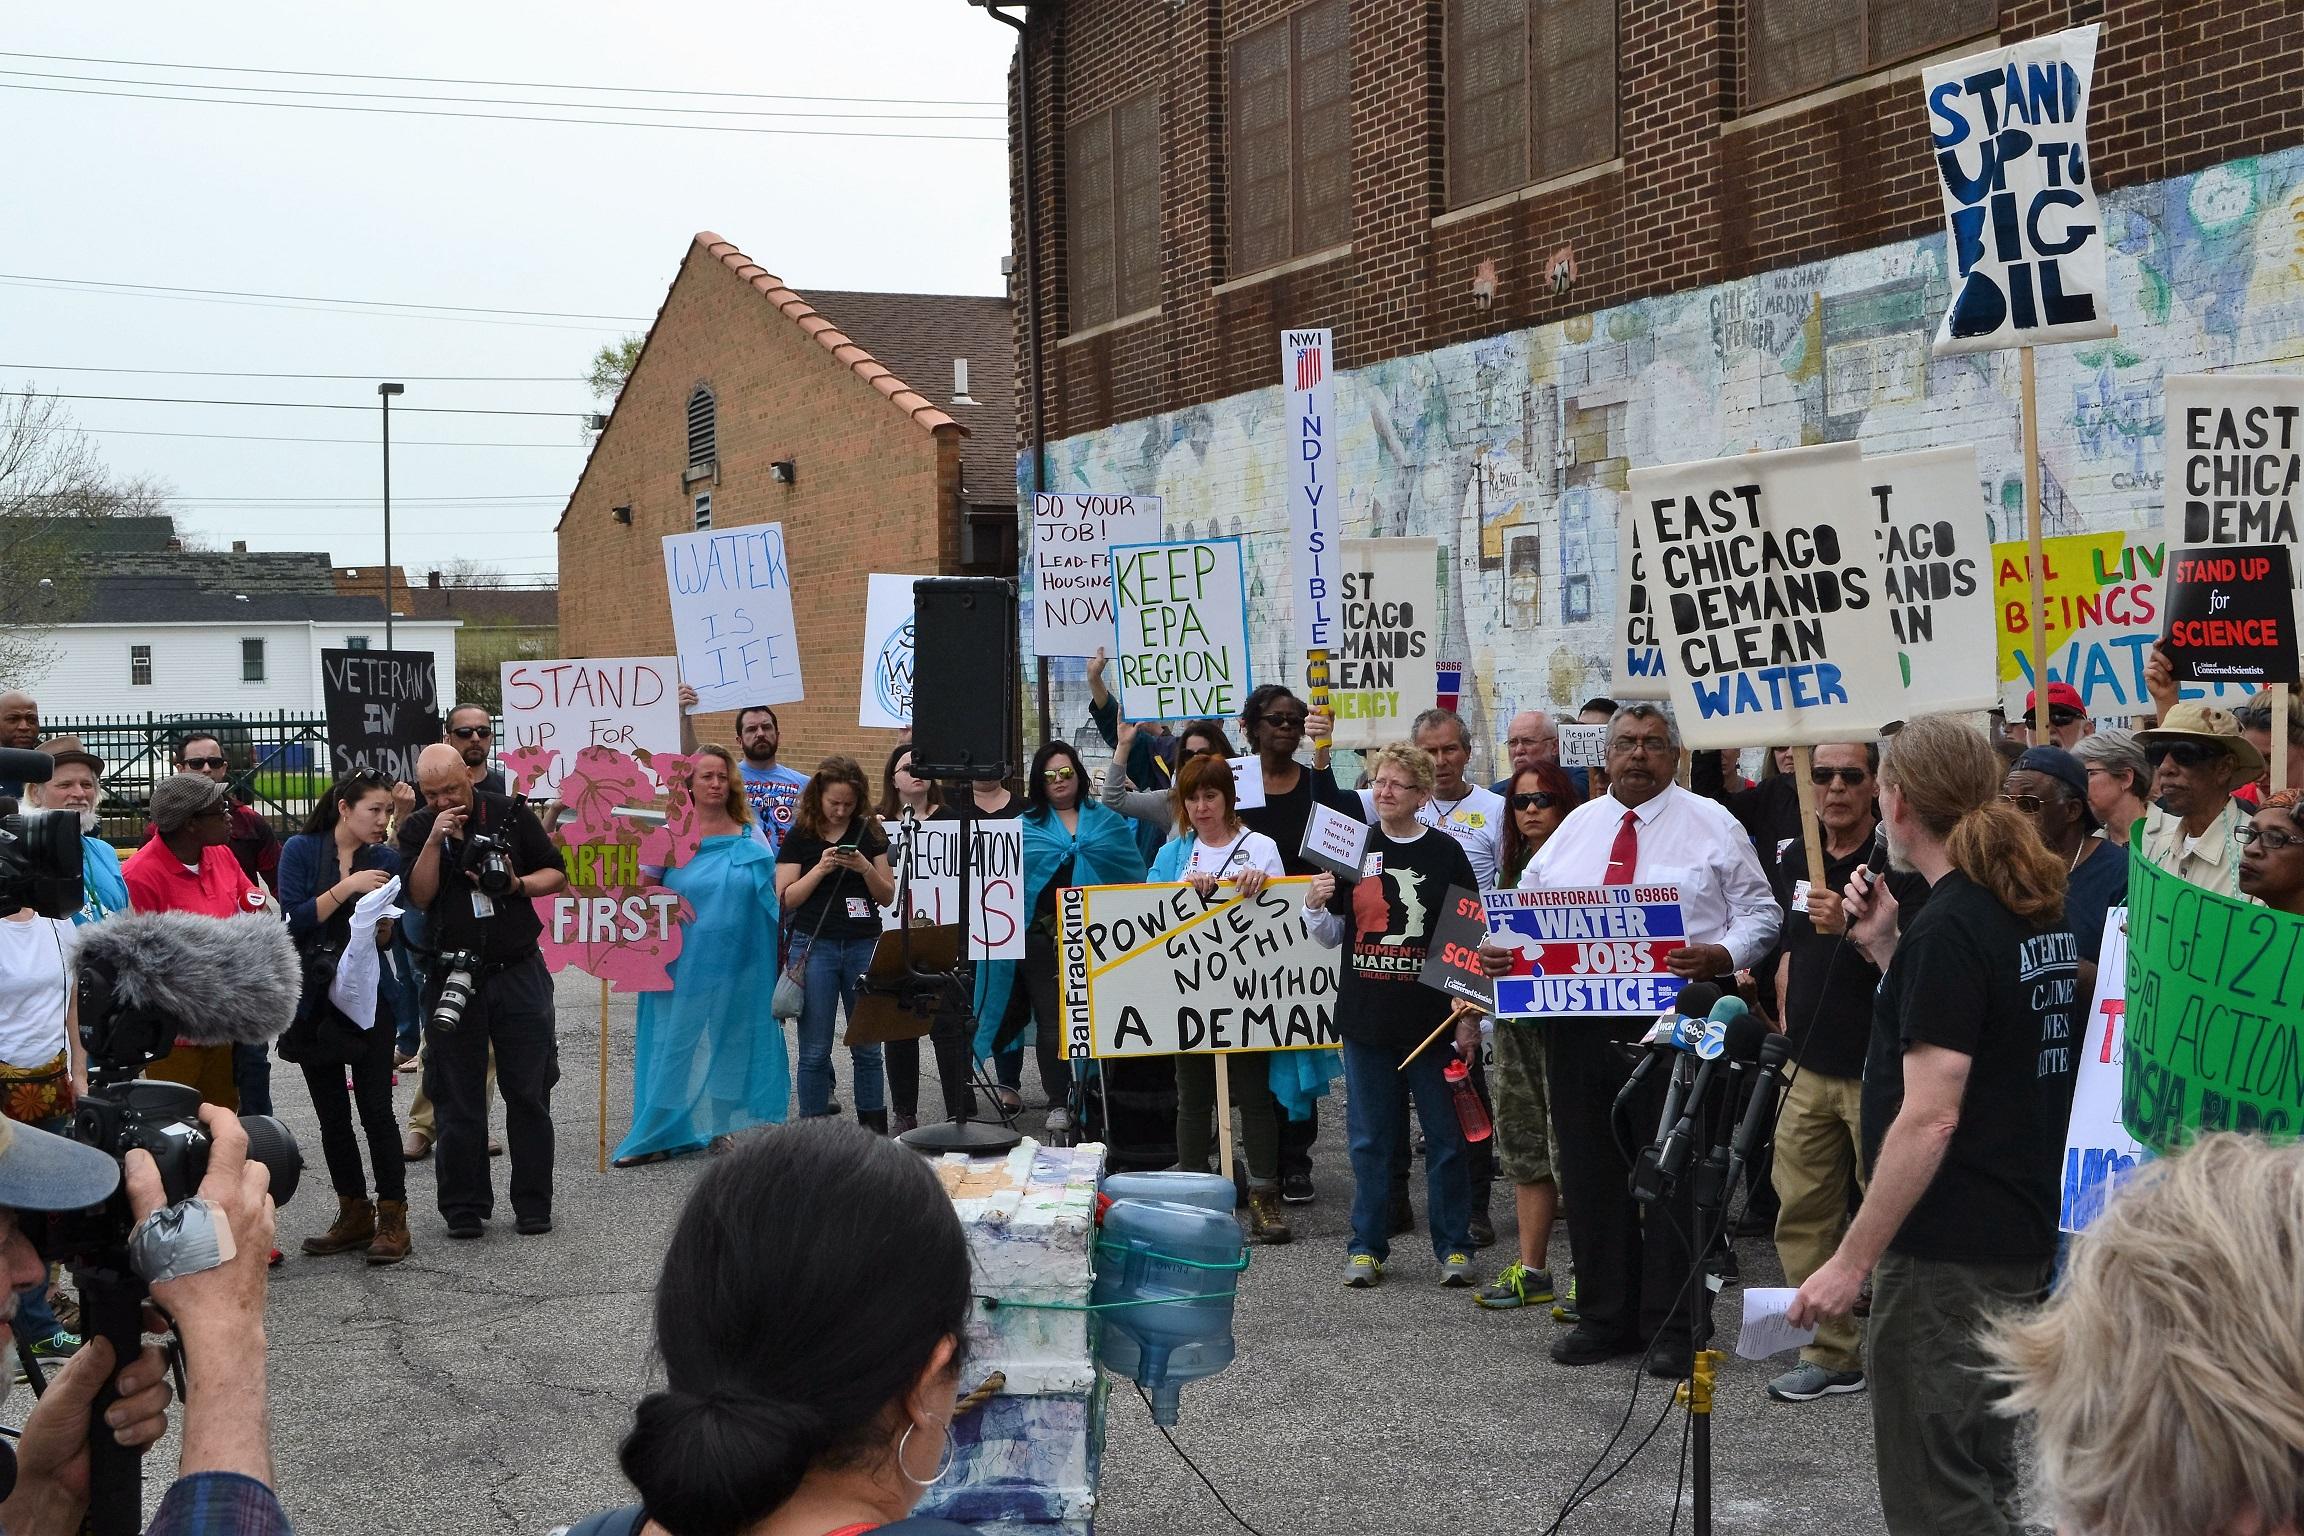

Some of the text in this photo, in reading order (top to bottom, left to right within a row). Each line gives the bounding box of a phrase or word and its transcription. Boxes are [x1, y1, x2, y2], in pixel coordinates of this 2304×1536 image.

[1929, 60, 2081, 149] STAND
[1937, 128, 2086, 206] UP TO
[1951, 189, 2097, 279] BIG
[1949, 259, 2097, 339] OIL
[1289, 333, 1321, 347] NWI
[2186, 406, 2299, 450] EAST
[1036, 494, 1064, 518] DO
[1076, 496, 1135, 520] YOUR
[1303, 394, 1331, 644] INDIVISIBLE
[1651, 484, 1761, 543] EAST
[2184, 501, 2298, 543] DEMA
[1040, 552, 1111, 568] LEAD-FR
[1662, 524, 1841, 589] CHICAGO
[1875, 521, 1955, 564] AGO
[674, 530, 788, 595] WATER
[1116, 545, 1216, 608] KEEP
[2092, 542, 2165, 586] LIV
[2176, 557, 2271, 583] STAND UP
[1043, 572, 1112, 590] HOUSING
[1342, 572, 1374, 600] ST
[1885, 558, 1977, 604] ANDS
[1342, 601, 1414, 630] ICAGO
[1670, 567, 1870, 635] DEMANDS
[2005, 583, 2155, 633] BEINGS
[2208, 589, 2230, 614] for
[701, 608, 754, 643] IS
[1140, 603, 1210, 647] EPA
[1627, 617, 1660, 645] CL
[2171, 619, 2279, 647] SCIENCE
[681, 634, 794, 690] LIFE
[1327, 631, 1426, 660] MANDS
[1681, 618, 1827, 678] CLEAN
[1121, 645, 1230, 688] REGION
[1436, 661, 1462, 672] 69866
[2198, 665, 2264, 675] Concerned Scientists
[326, 658, 437, 714] VETERANS
[510, 665, 663, 710] STAND
[1157, 684, 1235, 719] FIVE
[1691, 662, 1848, 720] WATER
[364, 703, 397, 735] IN
[517, 718, 638, 749] UP FOR
[1566, 729, 1596, 739] Region
[1586, 754, 1606, 766] EP
[1324, 828, 1341, 841] There
[1328, 818, 1355, 836] Save EPA
[561, 844, 639, 887] ARTH
[1456, 897, 1486, 924] STA
[1483, 887, 1679, 908] TEXT WATERFORALL TO 69866
[553, 894, 679, 944] FIRST
[1085, 883, 1231, 962] POWER
[1166, 889, 1290, 959] GIVES
[1534, 907, 1650, 939] WATER
[1352, 954, 1426, 971] MARCH
[1354, 942, 1426, 958] WOMEN'S
[1442, 942, 1490, 979] SCIE
[1571, 942, 1655, 974] JOBS
[2229, 913, 2278, 998] 2
[1062, 889, 1091, 1060] BanFracking
[1233, 965, 1340, 1000] WITHOU
[1360, 970, 1390, 980] CHICAGO
[1397, 973, 1414, 982] USA
[1448, 981, 1475, 997] Concerned
[1525, 978, 1656, 1012] JUSTICE
[2126, 951, 2160, 1056] PA
[1114, 1003, 1340, 1051] A DEMAN
[1658, 1022, 1676, 1032] WGN
[1685, 1024, 1703, 1039] abc
[1156, 1262, 1188, 1274] PRIMO
